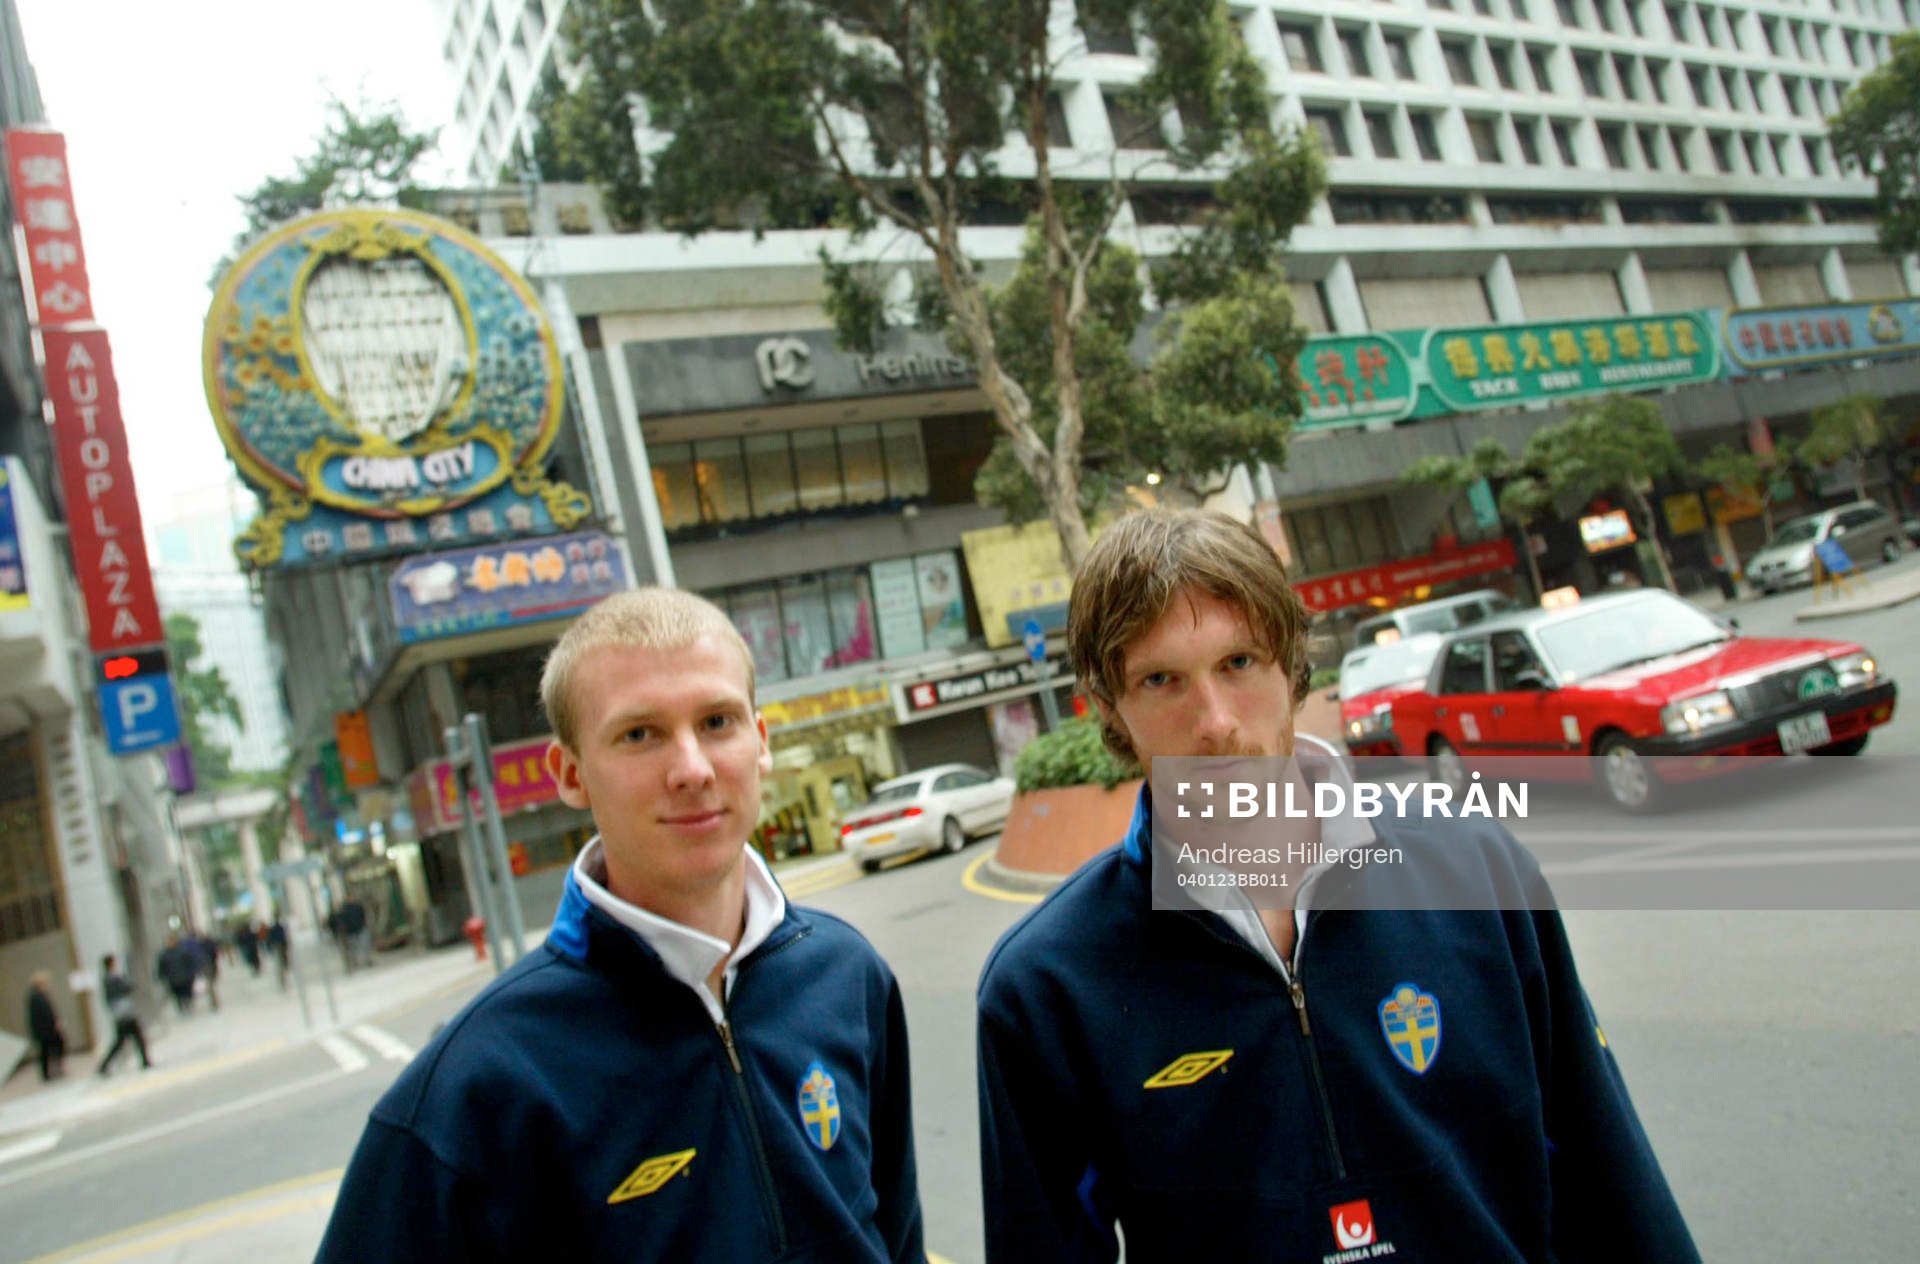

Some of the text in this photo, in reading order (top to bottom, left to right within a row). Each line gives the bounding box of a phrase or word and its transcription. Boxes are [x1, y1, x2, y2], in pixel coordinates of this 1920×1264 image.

[342, 441, 475, 489] CHINA CITY
[66, 341, 141, 639] AUTOPLAZA
[117, 684, 158, 730] P
[1371, 1241, 1396, 1257] SPEL
